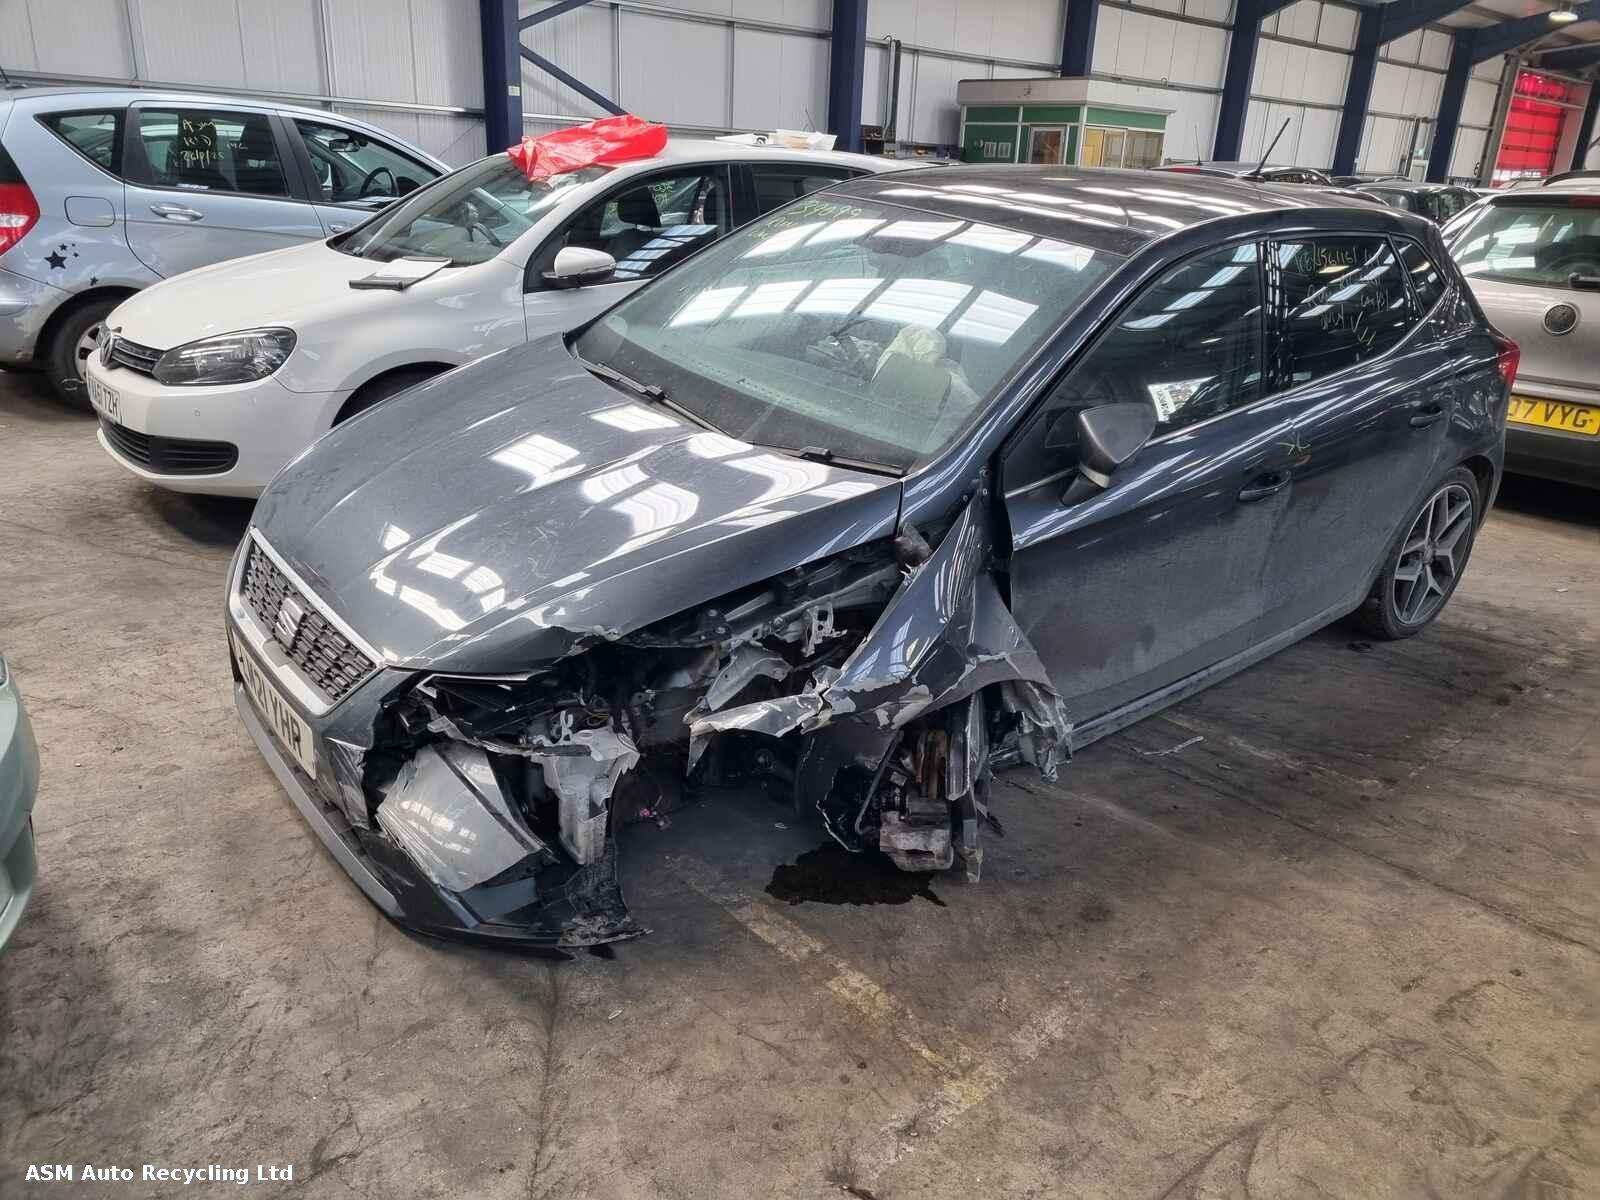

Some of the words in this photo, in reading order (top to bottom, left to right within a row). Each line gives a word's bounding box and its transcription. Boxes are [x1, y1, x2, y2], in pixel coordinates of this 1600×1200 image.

[103, 386, 119, 417] TZH
[1544, 402, 1591, 428] VYG
[269, 688, 303, 760] YHR
